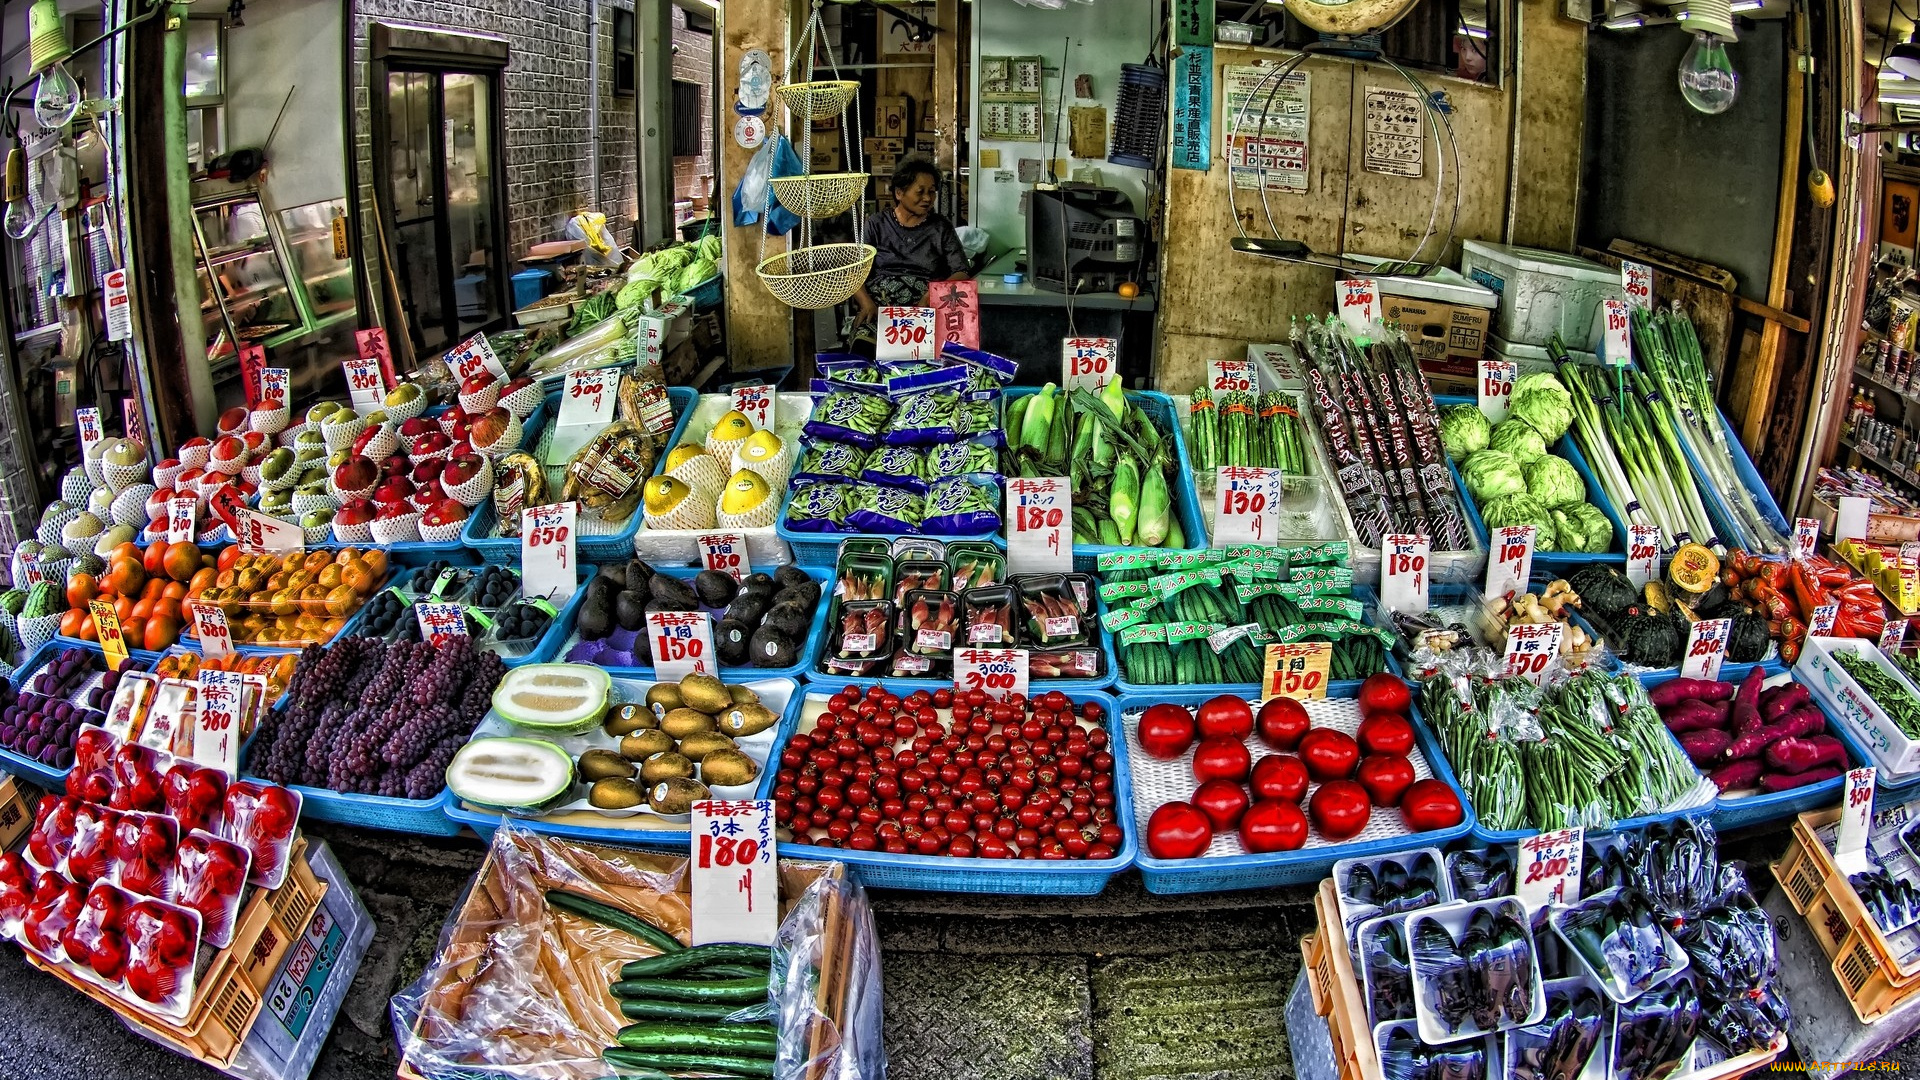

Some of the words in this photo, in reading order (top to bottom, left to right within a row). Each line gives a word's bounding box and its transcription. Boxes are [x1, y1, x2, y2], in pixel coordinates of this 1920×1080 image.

[1187, 52, 1202, 163] 杉並区青果産直販売店
[1175, 108, 1185, 147] 杉並区
[1344, 293, 1373, 307] 200
[881, 307, 922, 319] 特売
[1452, 313, 1482, 324] SUMIFRU
[892, 318, 915, 327] 1袋
[1609, 314, 1626, 330] 130
[885, 326, 926, 345] 350
[1067, 338, 1109, 349] 特売
[1107, 339, 1116, 362] 高原
[1077, 348, 1101, 358] 1本
[459, 354, 482, 378] 600
[1071, 357, 1107, 375] 130
[1482, 361, 1512, 370] 特売
[352, 374, 378, 388] 350
[577, 376, 602, 385] 1パック
[1214, 377, 1249, 390] 250
[1485, 378, 1511, 396] 150
[264, 388, 284, 401] 600
[571, 384, 603, 398] 300
[735, 398, 770, 411] 350
[84, 430, 99, 442] 680
[1325, 409, 1349, 463] 新ごぼう
[1388, 413, 1409, 464] 新ごぼう
[1406, 410, 1431, 461] 新ごぼう
[1222, 467, 1269, 480] 特売
[1009, 479, 1063, 494] 特売
[1232, 479, 1262, 491] 1パック
[1021, 494, 1055, 506] 1パック
[1268, 471, 1280, 515] やわらかい
[1224, 490, 1266, 514] 130
[526, 505, 570, 519] 特売
[1017, 506, 1063, 532] 180
[173, 518, 191, 532] 500
[534, 516, 562, 527] 1パック
[529, 526, 568, 547] 650
[1499, 526, 1536, 537] 特売
[1630, 525, 1654, 535] 特売
[699, 534, 740, 546] 特売
[1387, 535, 1429, 546] 特売
[709, 544, 732, 555] 1個
[1241, 548, 1272, 559] オクラ
[1305, 546, 1333, 558] オクラ
[1499, 544, 1526, 563] 100
[1631, 544, 1655, 560] 200
[707, 553, 740, 570] 180
[1115, 555, 1147, 564] オクラ
[1174, 554, 1206, 564] オクラ
[1389, 554, 1424, 575] 180
[1306, 568, 1337, 579] オクラ
[1118, 584, 1148, 593] オクラ
[1304, 579, 1335, 593] オクラ
[1313, 598, 1346, 610] オクラ
[424, 613, 460, 626] 特売
[650, 612, 706, 626] 特売
[1047, 617, 1070, 625] みょうが
[101, 626, 119, 641] 500
[201, 621, 227, 637] 580
[664, 624, 692, 638] 1個
[920, 629, 943, 638] みょうが
[973, 624, 993, 632] みょうが
[1185, 625, 1214, 634] オクラ
[1510, 624, 1554, 640] 特売
[1693, 621, 1722, 633] 特売
[846, 634, 867, 642] みょうが
[1699, 630, 1715, 641] 1個
[658, 636, 703, 662] 150
[1268, 643, 1331, 656] 特売
[1515, 640, 1540, 652] 1袋
[1689, 639, 1720, 657] 250
[960, 650, 1023, 664] 特売
[1276, 657, 1305, 671] 1個
[200, 671, 227, 685] 青森県
[966, 673, 1016, 689] 300
[1270, 670, 1322, 696] 150
[201, 685, 232, 700] 特売
[206, 699, 226, 710] 1パック
[201, 710, 231, 731] 380
[1836, 690, 1891, 752] さやえんどう
[1850, 787, 1871, 807] 350
[693, 800, 757, 817] 特売
[710, 817, 744, 837] 3本
[1522, 830, 1571, 852] 特売
[699, 834, 758, 868] 180
[1536, 848, 1565, 861] 1パック
[1525, 858, 1568, 884] 200
[291, 944, 313, 978] LC-CA
[273, 980, 292, 1011] 26
